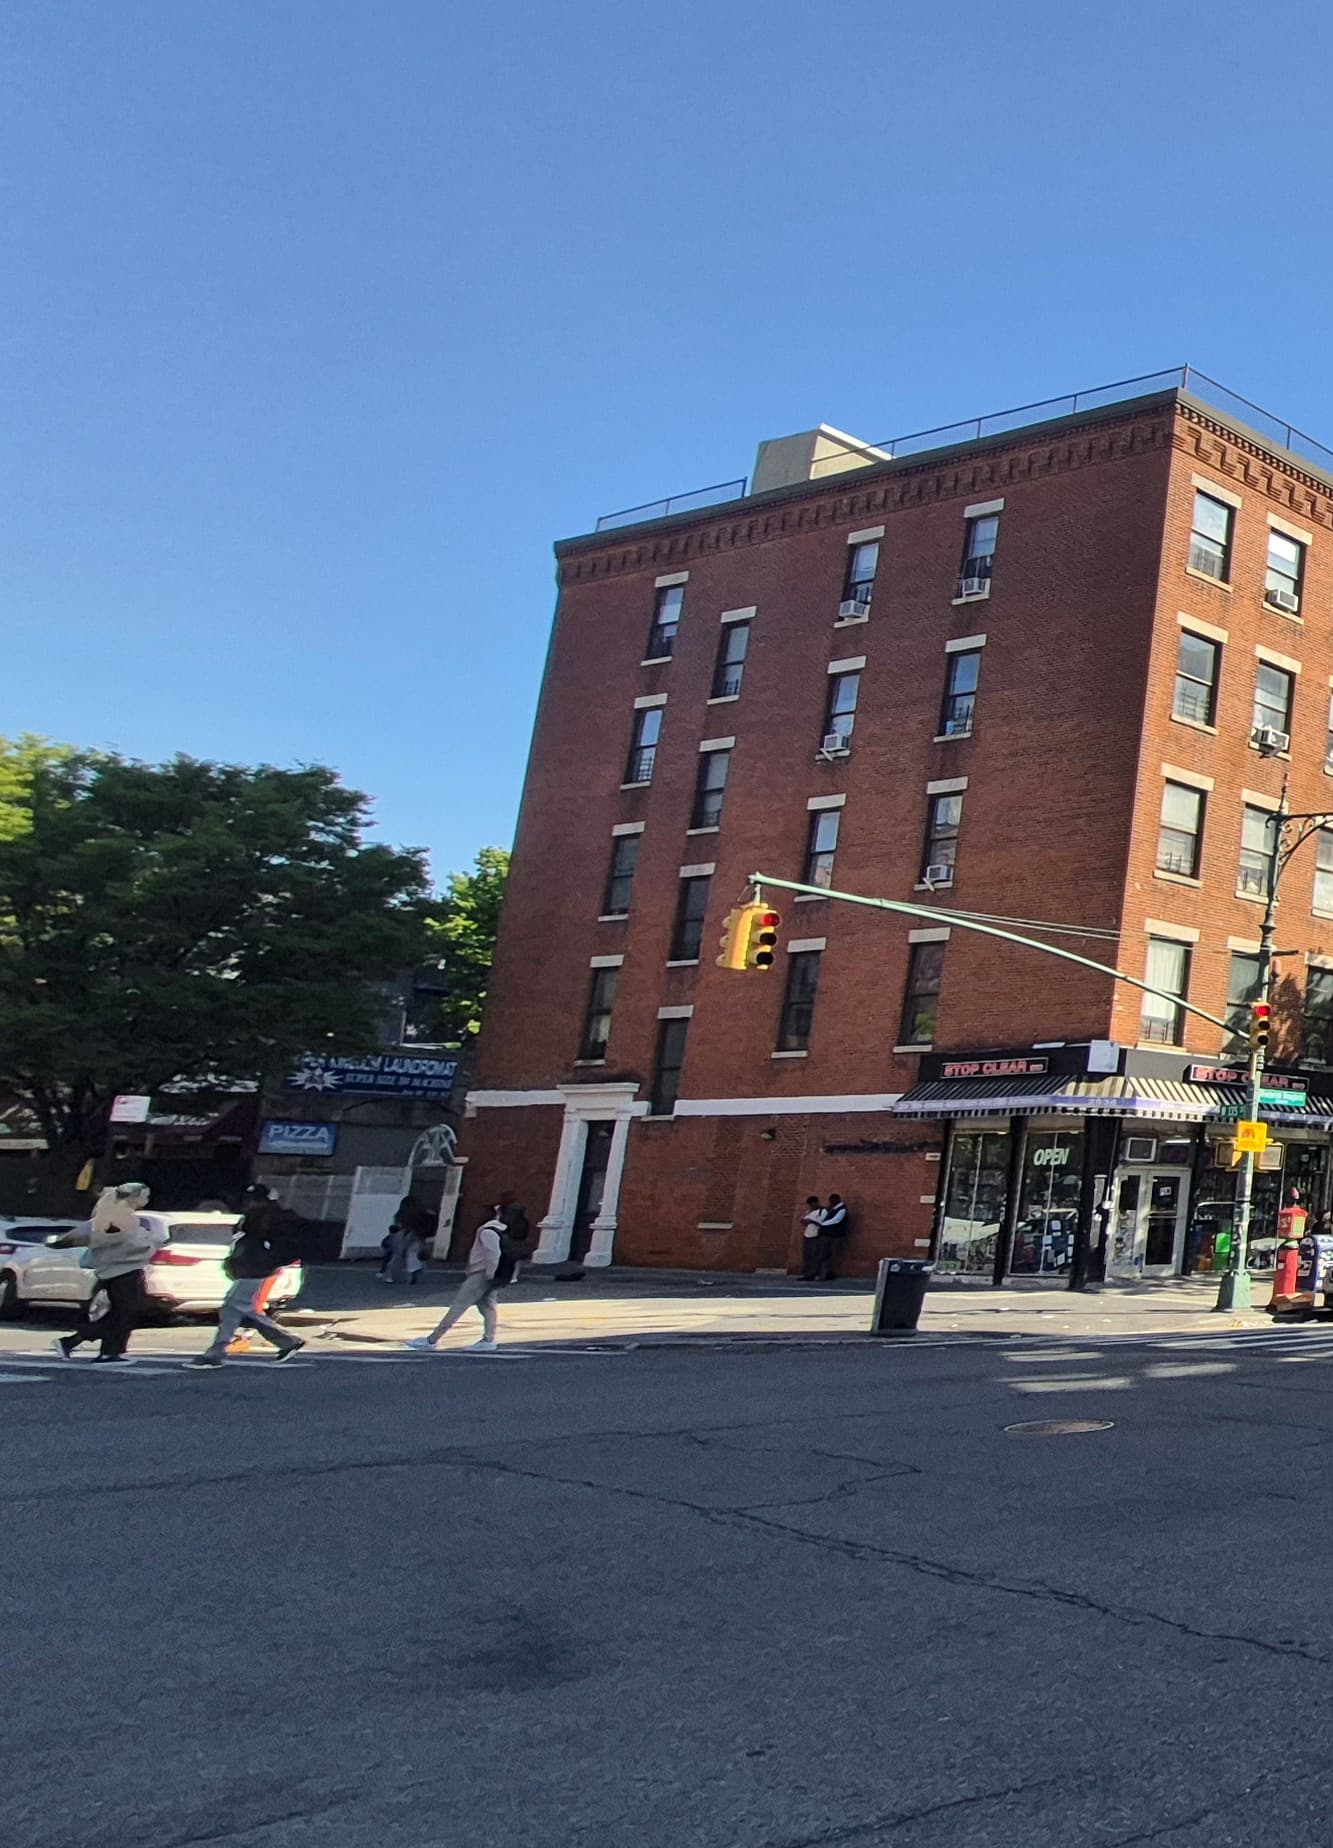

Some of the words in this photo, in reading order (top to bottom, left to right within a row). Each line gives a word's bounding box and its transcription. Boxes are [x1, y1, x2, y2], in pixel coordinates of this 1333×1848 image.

[944, 1063, 980, 1077] STOP
[983, 1061, 1027, 1075] CLEAR
[1194, 1067, 1238, 1083] STOP
[1241, 1073, 1289, 1088] CEAR
[268, 1124, 329, 1141] PIZZA
[1033, 1148, 1070, 1166] OPEN
